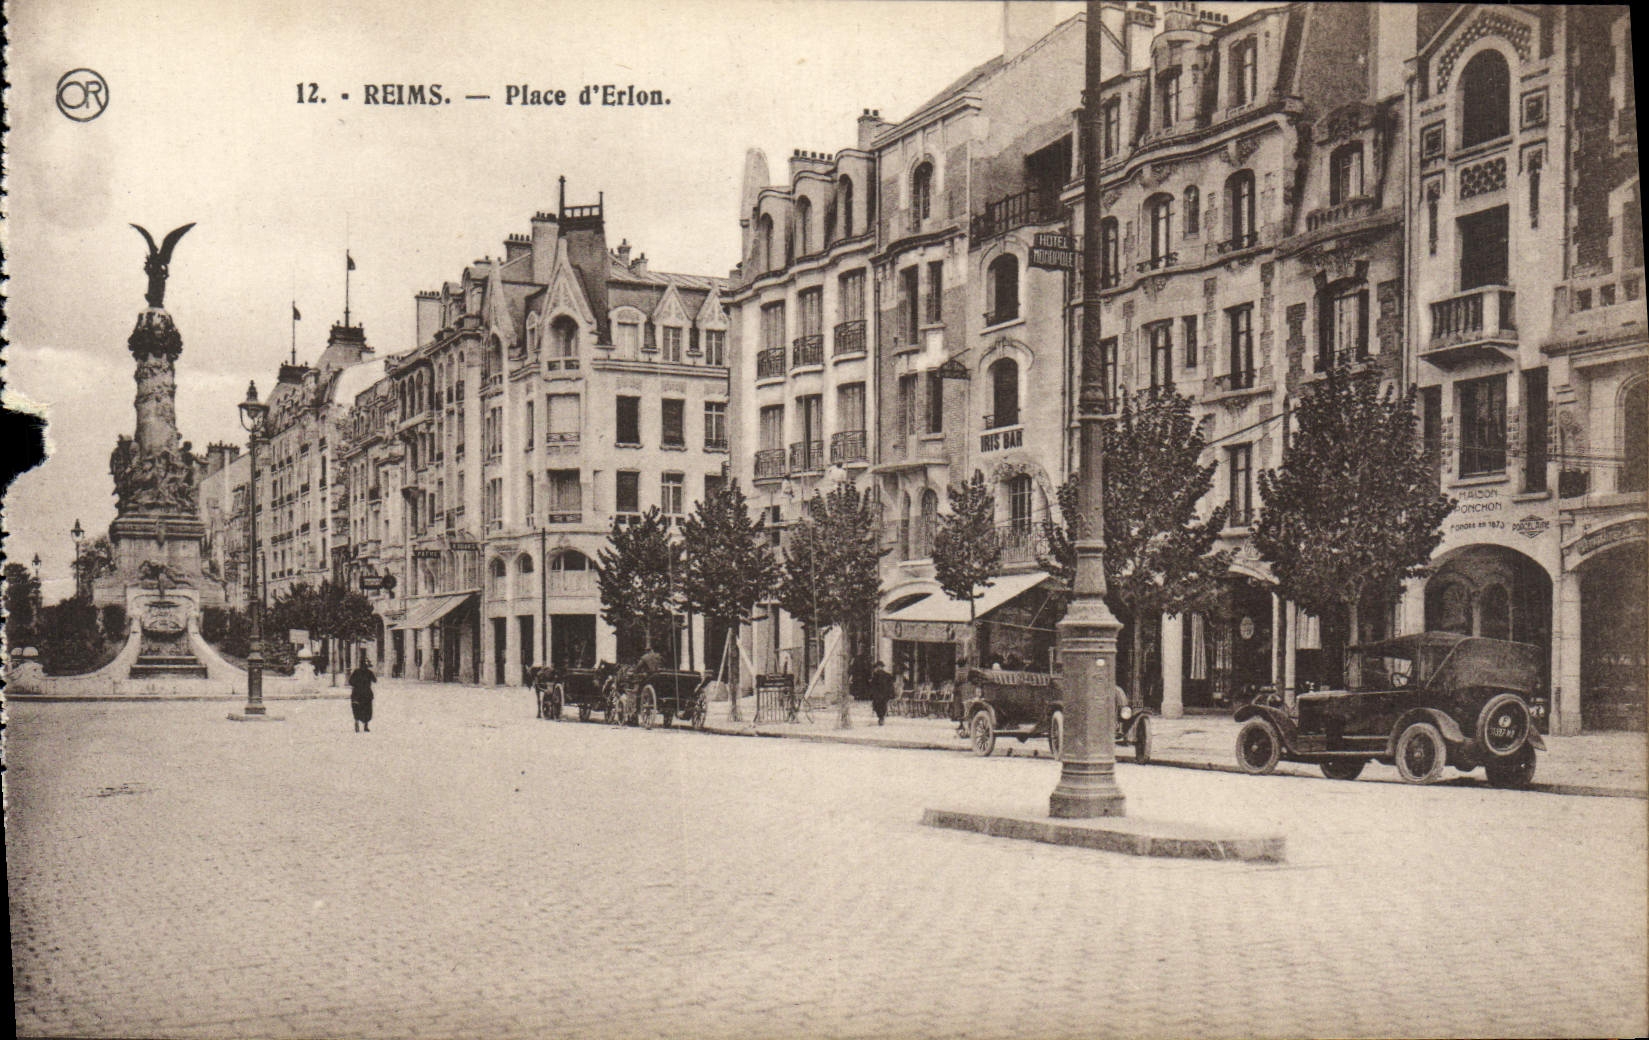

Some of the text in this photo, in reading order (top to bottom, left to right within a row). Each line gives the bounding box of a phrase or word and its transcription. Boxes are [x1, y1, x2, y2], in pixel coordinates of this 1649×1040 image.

[1040, 234, 1068, 249] HOTEL
[980, 430, 1023, 452] IRIS BAR
